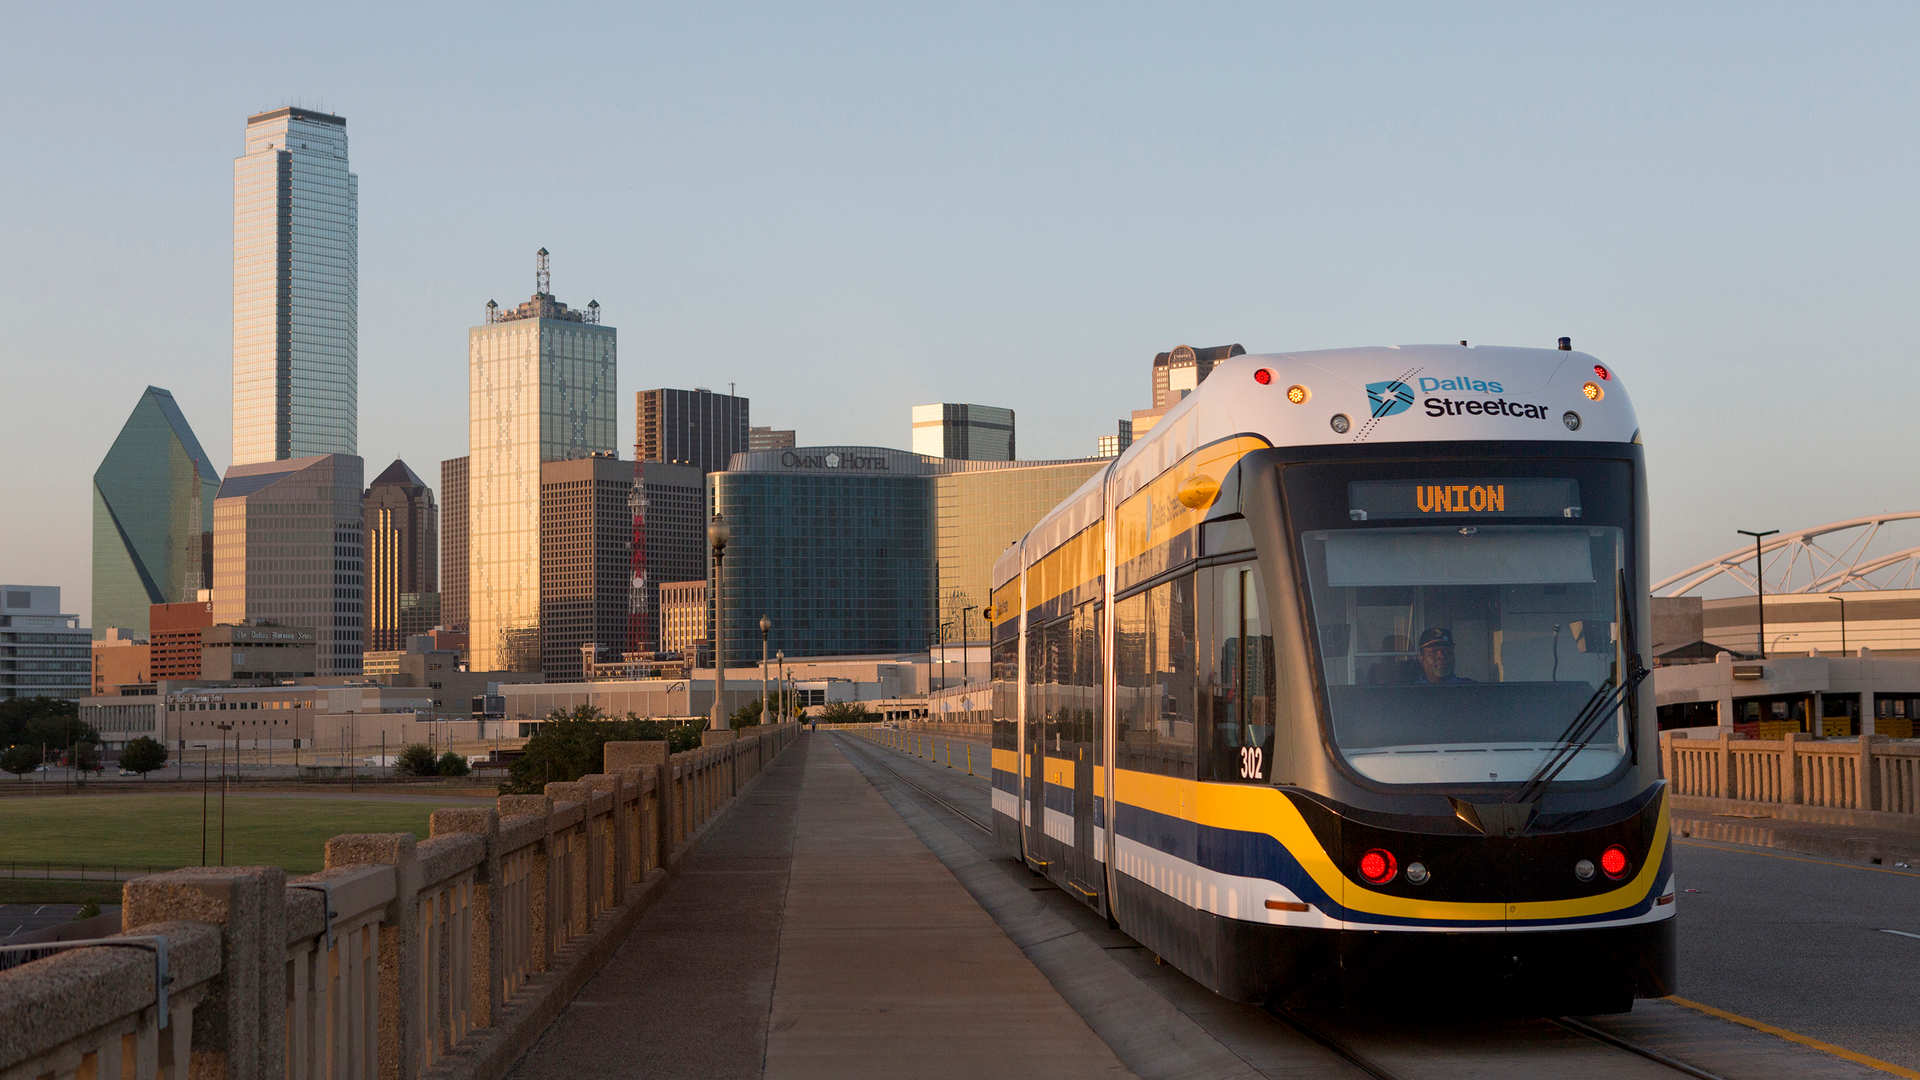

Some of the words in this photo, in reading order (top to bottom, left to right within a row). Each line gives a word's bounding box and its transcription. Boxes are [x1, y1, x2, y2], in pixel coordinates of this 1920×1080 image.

[1419, 376, 1504, 393] Dallas
[1424, 397, 1549, 420] Streetcar
[781, 451, 823, 468] OMNI
[841, 452, 889, 470] HOTEL
[1416, 485, 1505, 512] UNION
[236, 630, 247, 640] The
[251, 630, 269, 639] Dallas
[272, 631, 295, 640] Morning
[297, 631, 312, 640] News
[1240, 746, 1263, 779] 302
